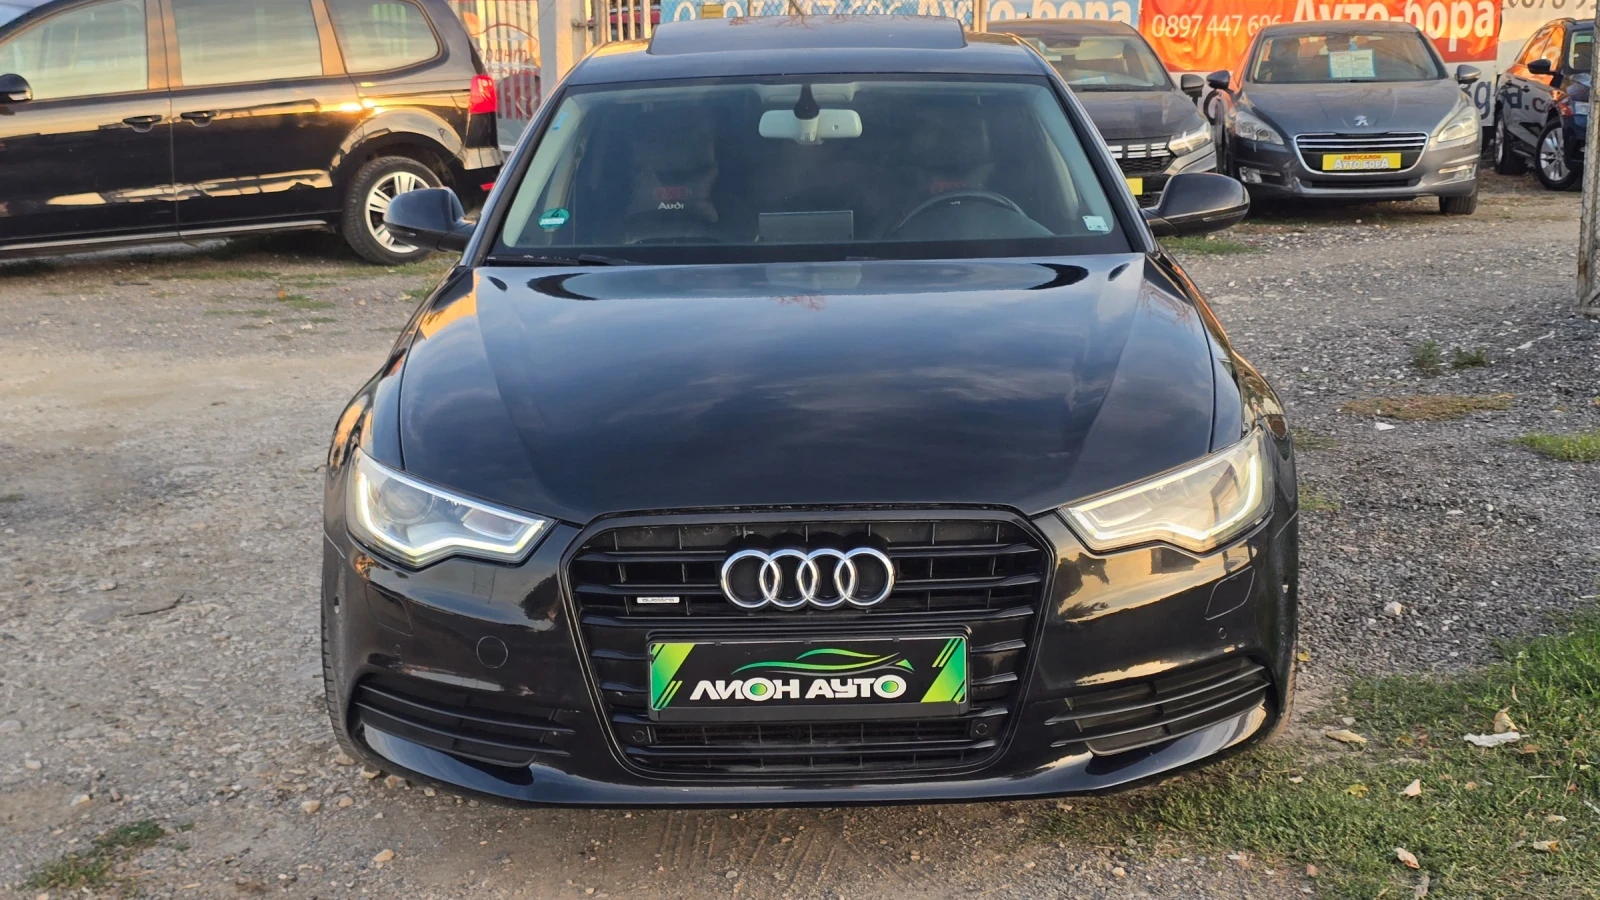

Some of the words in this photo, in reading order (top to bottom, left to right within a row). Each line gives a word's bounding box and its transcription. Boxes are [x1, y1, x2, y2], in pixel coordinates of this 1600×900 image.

[1151, 15, 1203, 38] 0897
[1206, 15, 1243, 37] 447
[658, 201, 685, 210] Audi
[690, 677, 800, 701] ЛИОН
[804, 674, 907, 699] АУТО
